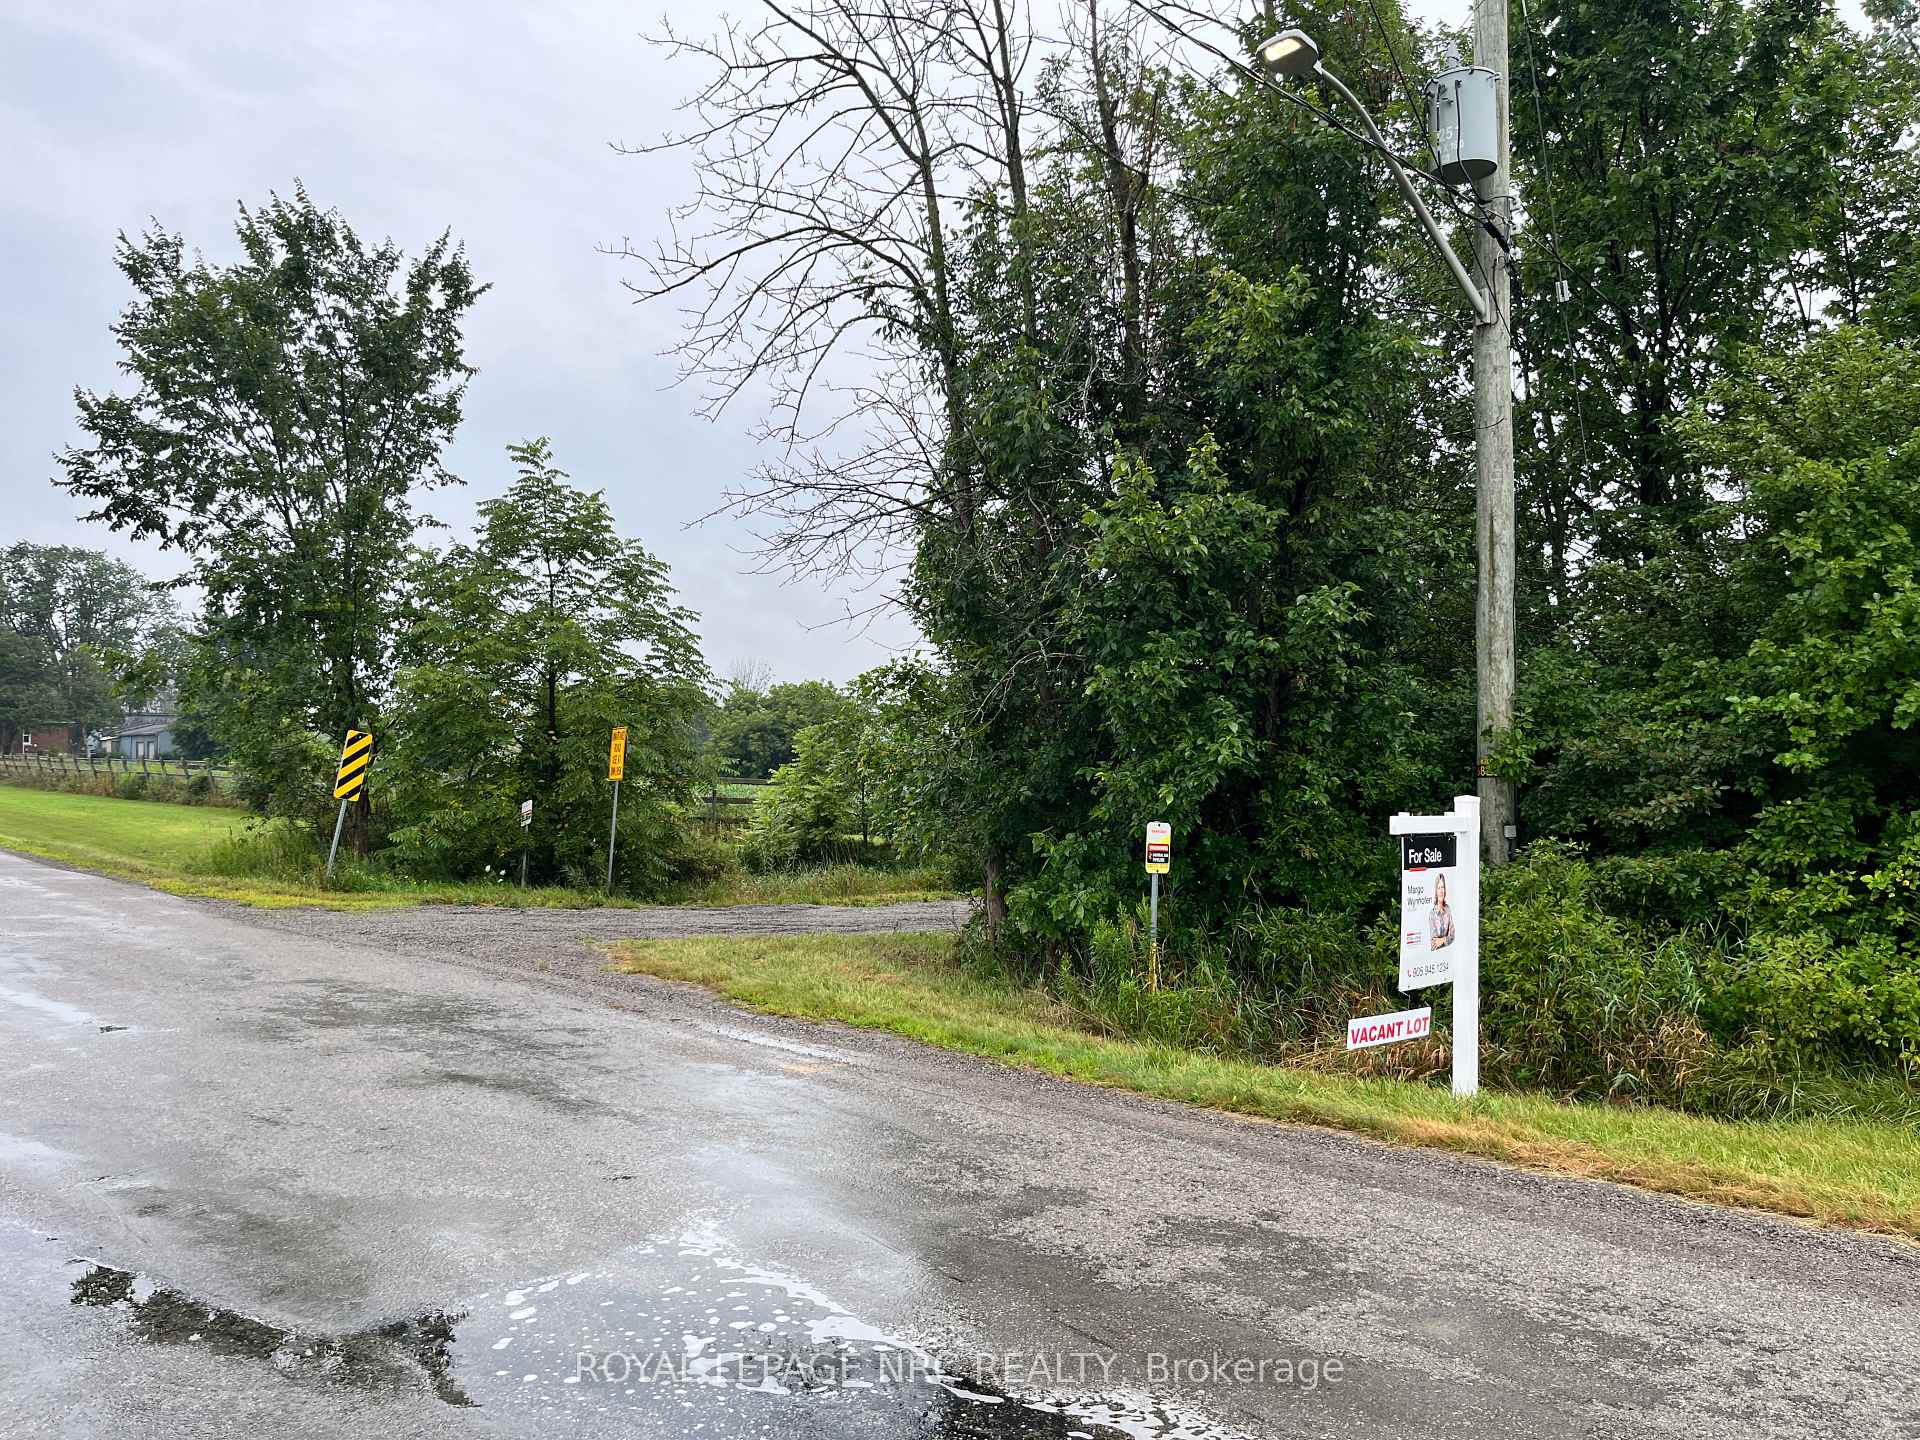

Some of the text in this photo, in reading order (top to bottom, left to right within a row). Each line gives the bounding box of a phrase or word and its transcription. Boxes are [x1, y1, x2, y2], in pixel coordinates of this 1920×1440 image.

[1409, 847, 1442, 864] For Sale
[1407, 885, 1424, 896] Margo
[1425, 963, 1436, 976] 945
[1437, 961, 1449, 973] 1234
[1351, 1016, 1429, 1045] VACANT LOT
